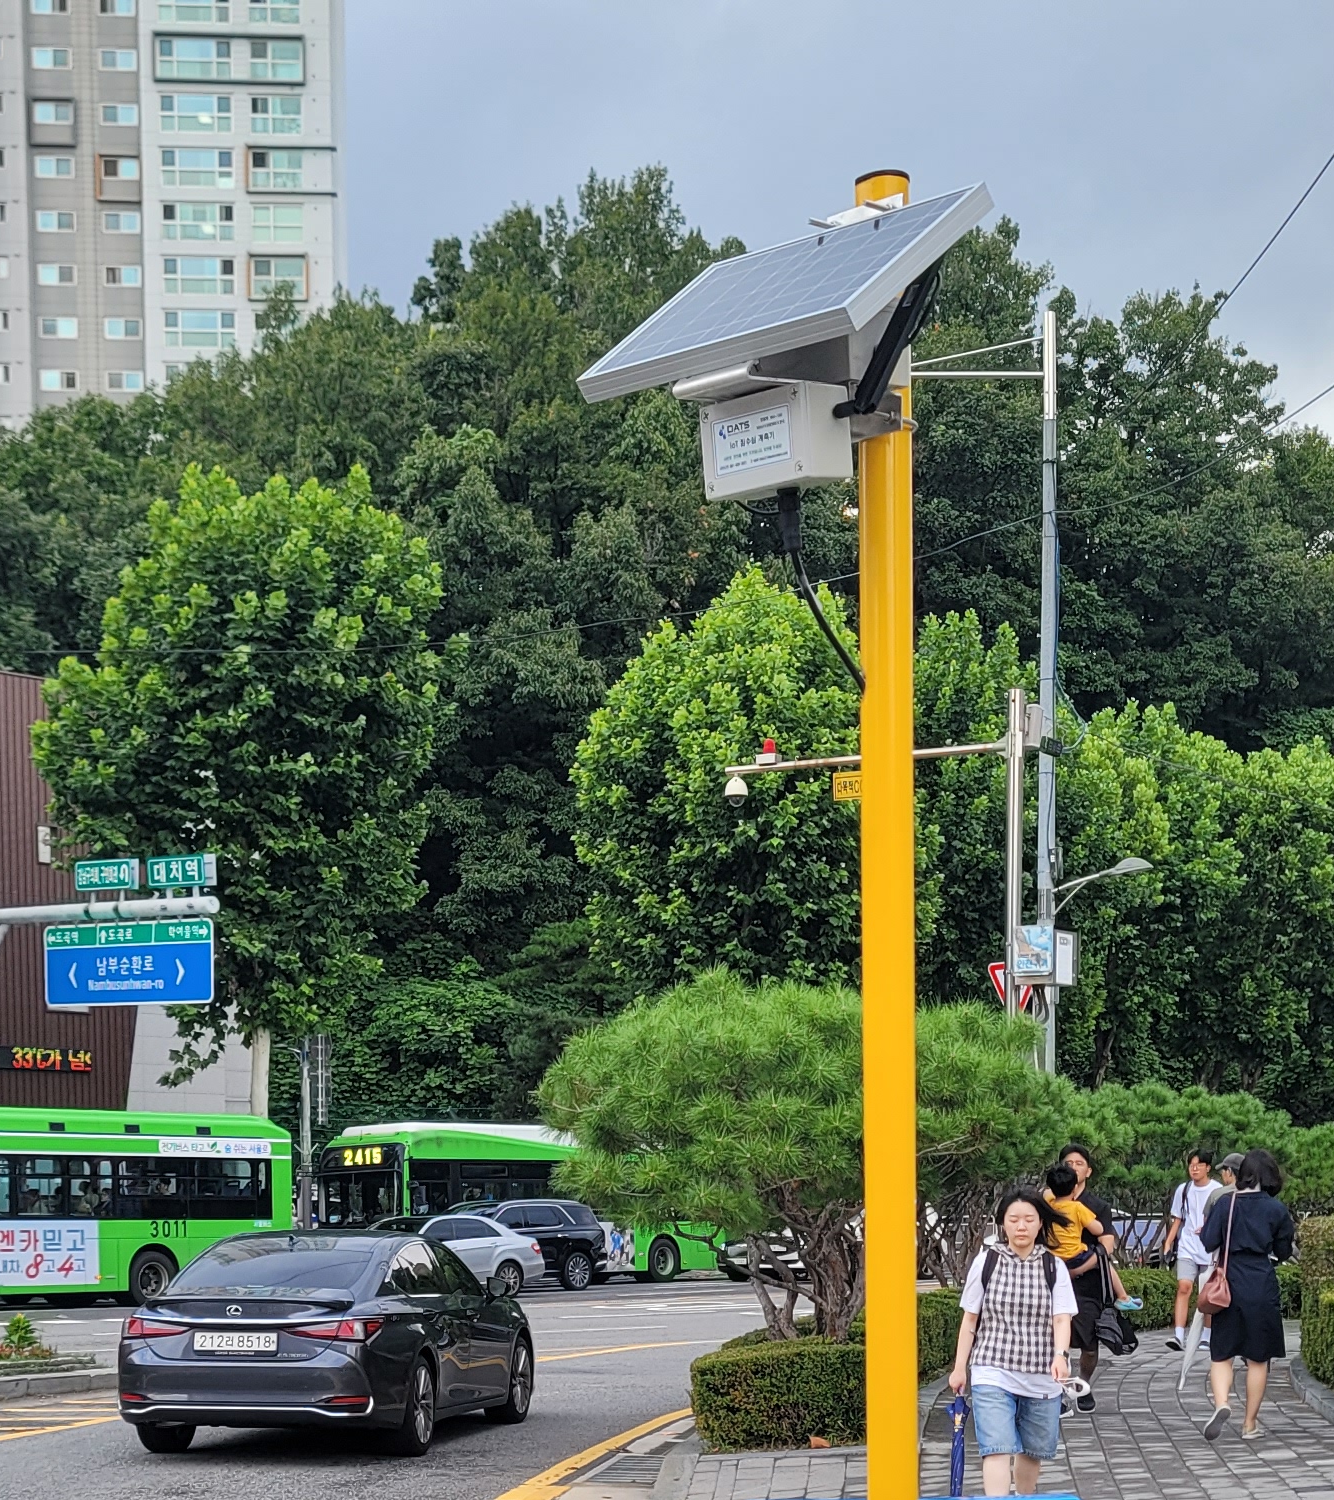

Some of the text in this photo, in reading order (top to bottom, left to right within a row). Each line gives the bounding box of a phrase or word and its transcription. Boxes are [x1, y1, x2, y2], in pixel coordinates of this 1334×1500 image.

[153, 859, 199, 882] 대치역
[107, 928, 133, 941] 도곡로
[96, 955, 155, 976] 남부순환로
[343, 1146, 382, 1166] 2415
[149, 1220, 187, 1239] 3011
[237, 1335, 271, 1348] 8518
